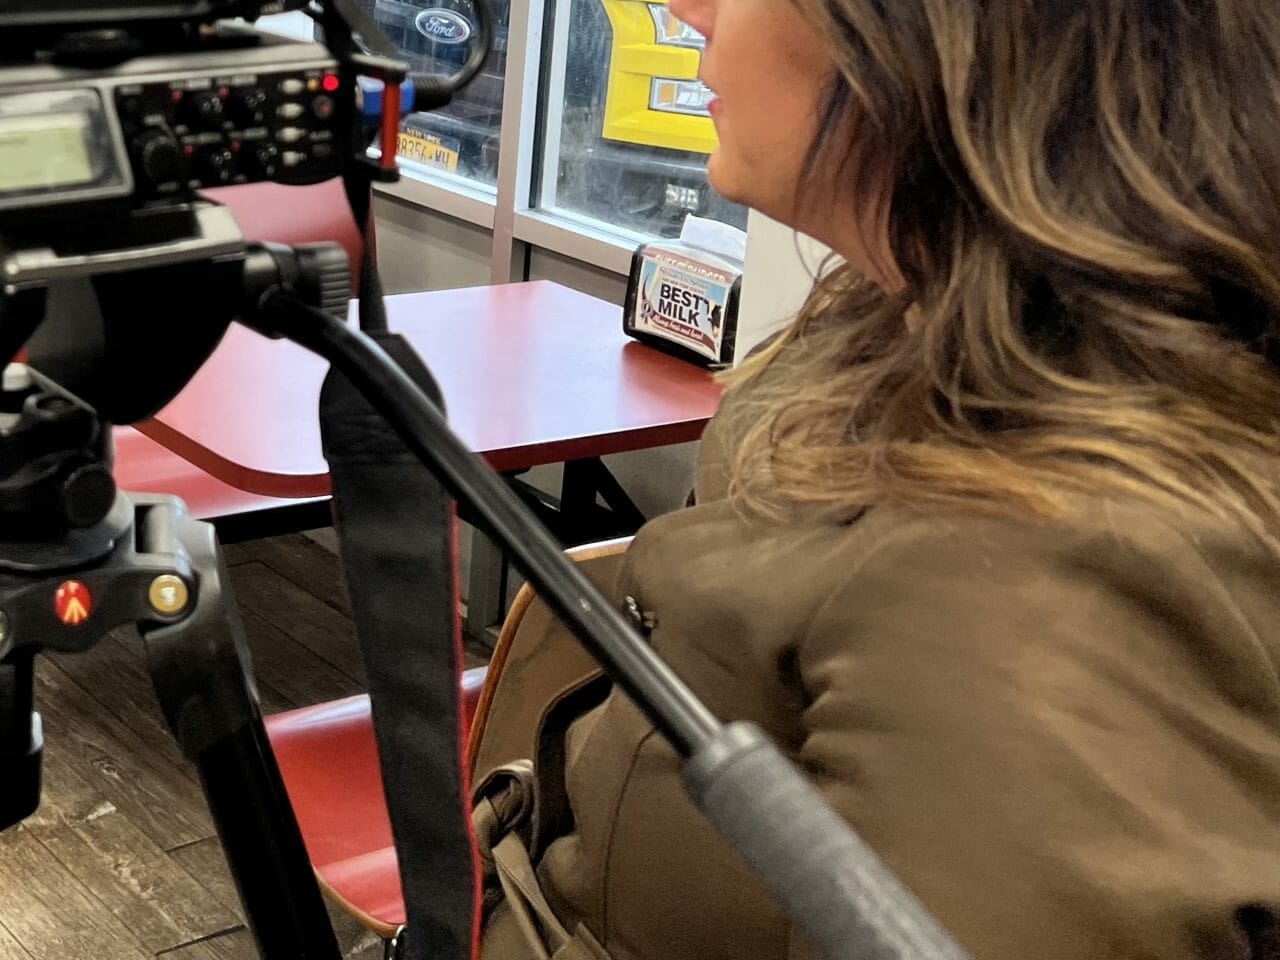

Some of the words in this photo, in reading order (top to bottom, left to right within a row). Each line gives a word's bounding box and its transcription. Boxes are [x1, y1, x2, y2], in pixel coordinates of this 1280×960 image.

[425, 16, 456, 38] Ford
[660, 283, 703, 310] BEST
[659, 299, 700, 327] MILK
